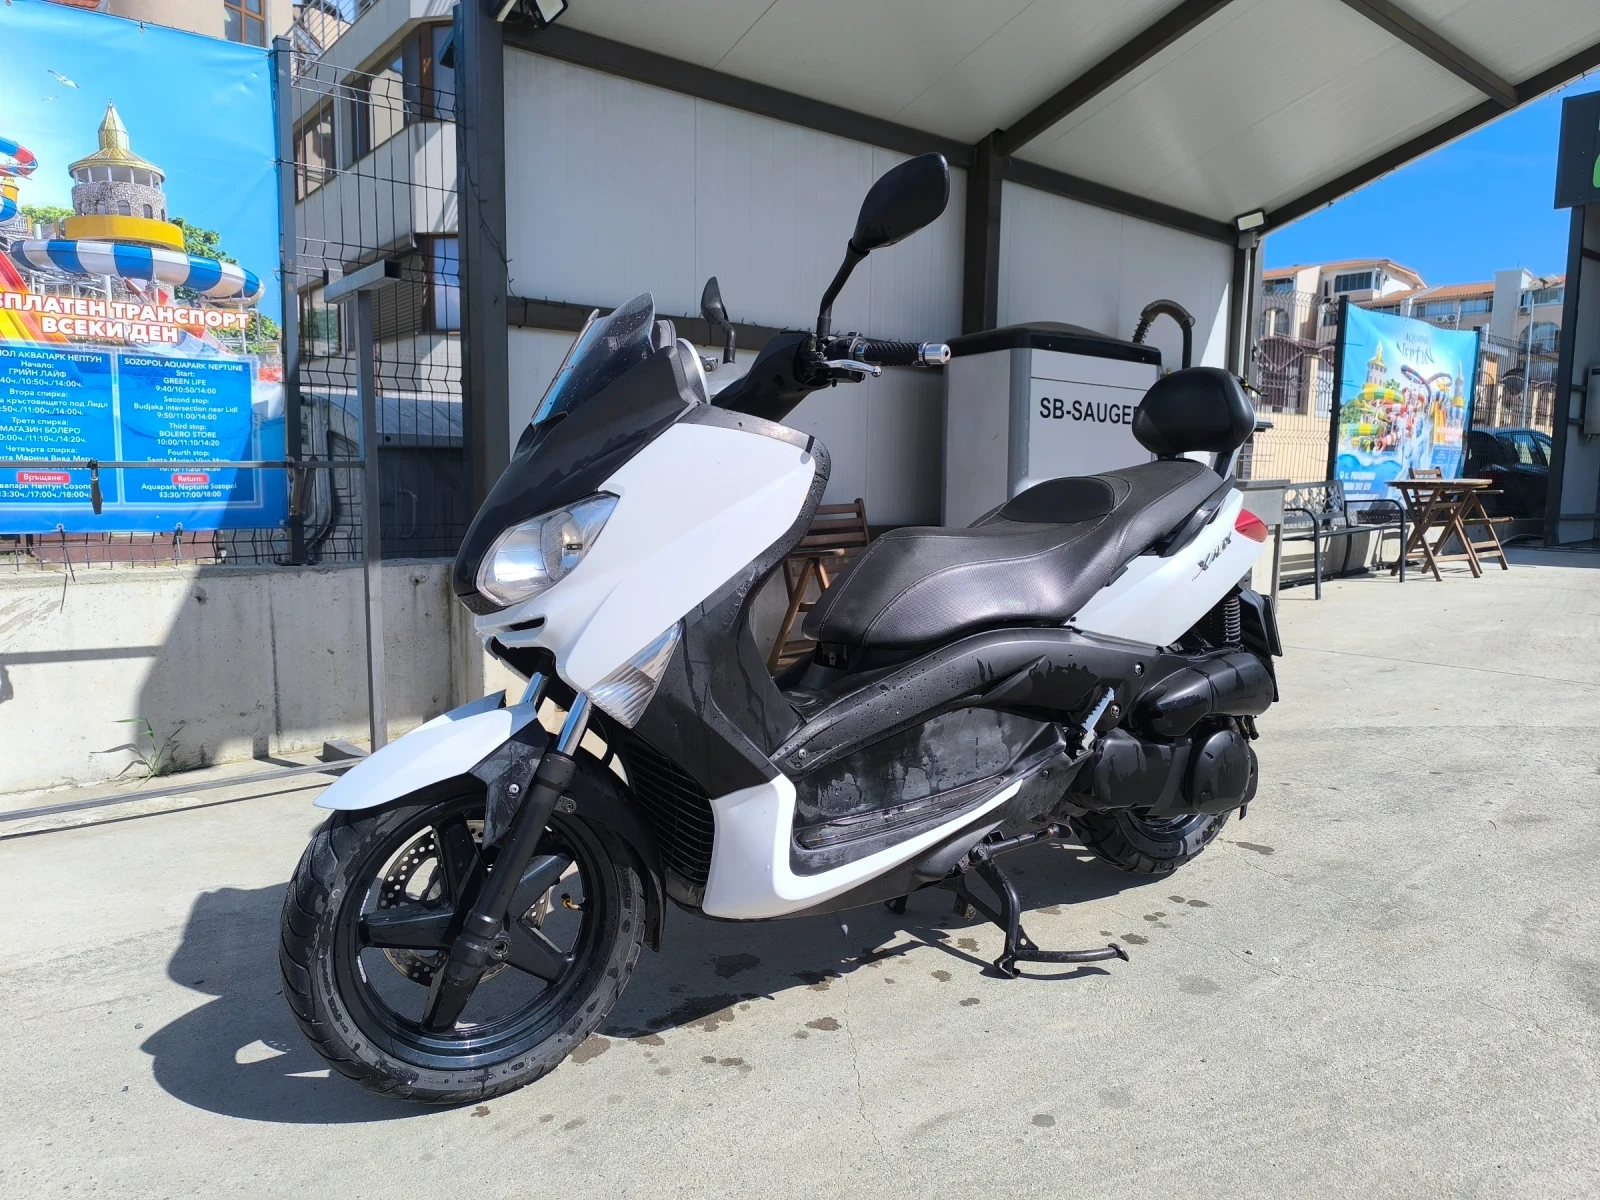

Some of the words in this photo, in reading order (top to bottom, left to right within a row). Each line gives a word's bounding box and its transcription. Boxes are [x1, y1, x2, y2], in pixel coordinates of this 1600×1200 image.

[111, 302, 249, 328] ТРАНСПОРТ
[41, 316, 123, 338] ВСЕКИ
[129, 323, 179, 343] ДЕН
[18, 351, 66, 360] АКВАПАРК
[67, 354, 102, 363] НЕПТУН
[20, 360, 54, 369] Начало:
[124, 357, 163, 367] SOZOPOL
[164, 360, 207, 370] AQUAPARK
[208, 363, 244, 372] NEPTUNE
[8, 367, 38, 377] ГРИЙН
[40, 368, 67, 378] ЛАЙФ
[175, 369, 196, 377] Start:
[163, 377, 190, 385] GREEN
[9, 388, 35, 397] Втора
[36, 390, 68, 399] спирка:
[155, 385, 217, 395] 9:40/10:50/14:00
[86, 400, 108, 408] Лидл
[163, 395, 190, 404] Second
[191, 397, 210, 405] stop:
[133, 402, 164, 411] Budjaka
[165, 404, 207, 412] intersection
[11, 416, 36, 426] Трета
[0, 425, 43, 433] МАГАЗИН
[44, 426, 81, 435] БОЛЕРО
[168, 422, 188, 430] Third
[159, 430, 191, 438] BOLERO
[192, 431, 217, 439] STORE
[156, 438, 220, 447] 10:00/11:10/14:20
[5, 444, 45, 454] Четвърта
[46, 446, 78, 454] спирка:
[167, 448, 191, 456] Fourth
[23, 473, 64, 482] Връщане:
[177, 475, 204, 483] Return:
[31, 483, 62, 491] Нептун
[141, 483, 177, 491] Aquapark
[210, 483, 237, 491] Sozopol
